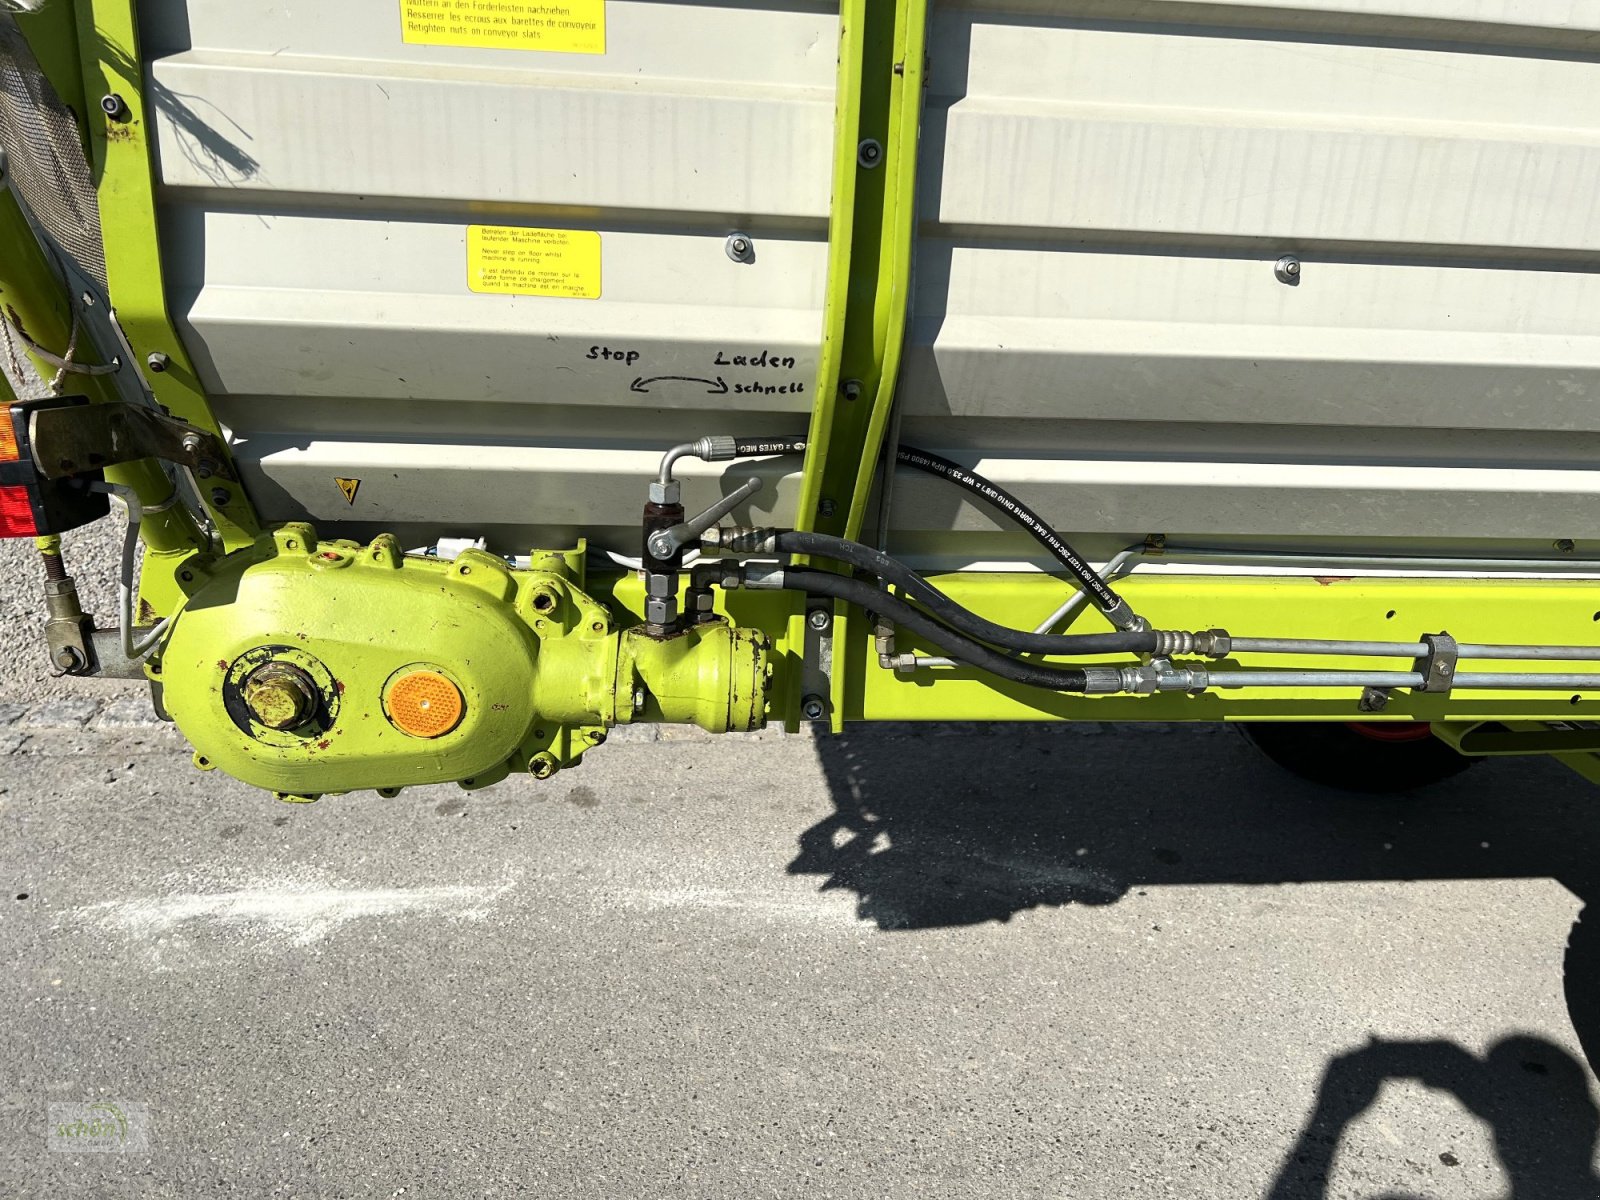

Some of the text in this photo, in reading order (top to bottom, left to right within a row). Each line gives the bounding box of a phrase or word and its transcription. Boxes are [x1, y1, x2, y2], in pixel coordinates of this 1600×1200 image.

[455, 0, 469, 9] den
[407, 8, 445, 20] Resserrer
[449, 11, 461, 22] les
[493, 16, 507, 25] aux
[511, 16, 544, 27] barettes
[546, 18, 556, 27] de
[408, 21, 446, 34] Retighten
[450, 26, 467, 35] nuts
[471, 28, 481, 36] on
[483, 28, 518, 39] conveyor
[481, 228, 507, 236] Betreten
[586, 345, 640, 366] Stop
[713, 350, 796, 368] Laden
[734, 381, 805, 395] schnell
[736, 444, 758, 453] MEG
[758, 443, 784, 452] GATES
[931, 462, 947, 472] MPa
[947, 469, 963, 479] 33.0
[962, 476, 975, 486] WP
[997, 495, 1015, 510] DN10
[1013, 506, 1035, 526] 100R16
[1033, 523, 1048, 537] SAE
[1048, 536, 1061, 549] R16
[1058, 546, 1071, 559] 2SC
[1068, 556, 1084, 572] 11237
[1081, 569, 1093, 581] ISO
[1091, 581, 1103, 592] 2SC
[1107, 598, 1117, 608] EN
